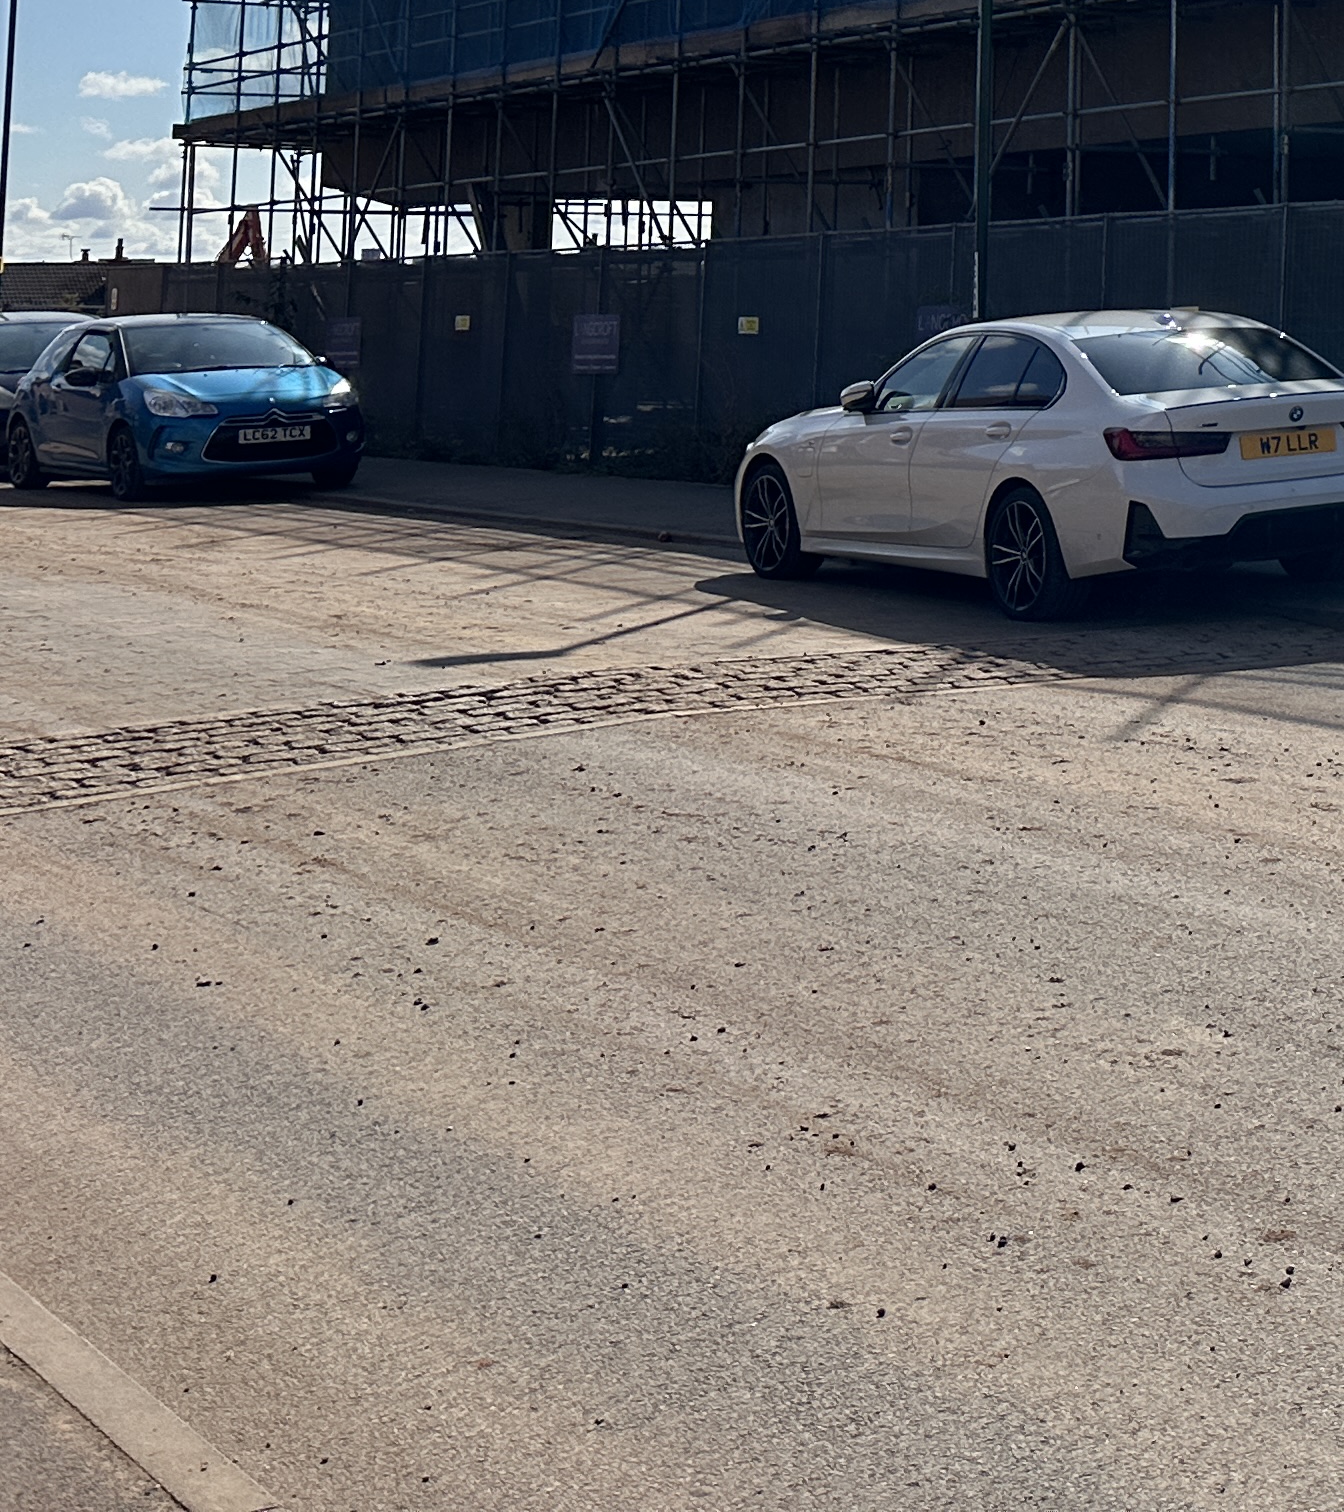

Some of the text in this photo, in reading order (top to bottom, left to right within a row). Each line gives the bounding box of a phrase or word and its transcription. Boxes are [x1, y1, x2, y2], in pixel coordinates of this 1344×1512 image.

[243, 426, 306, 442] LC62 TCX
[1286, 433, 1319, 452] LLR
